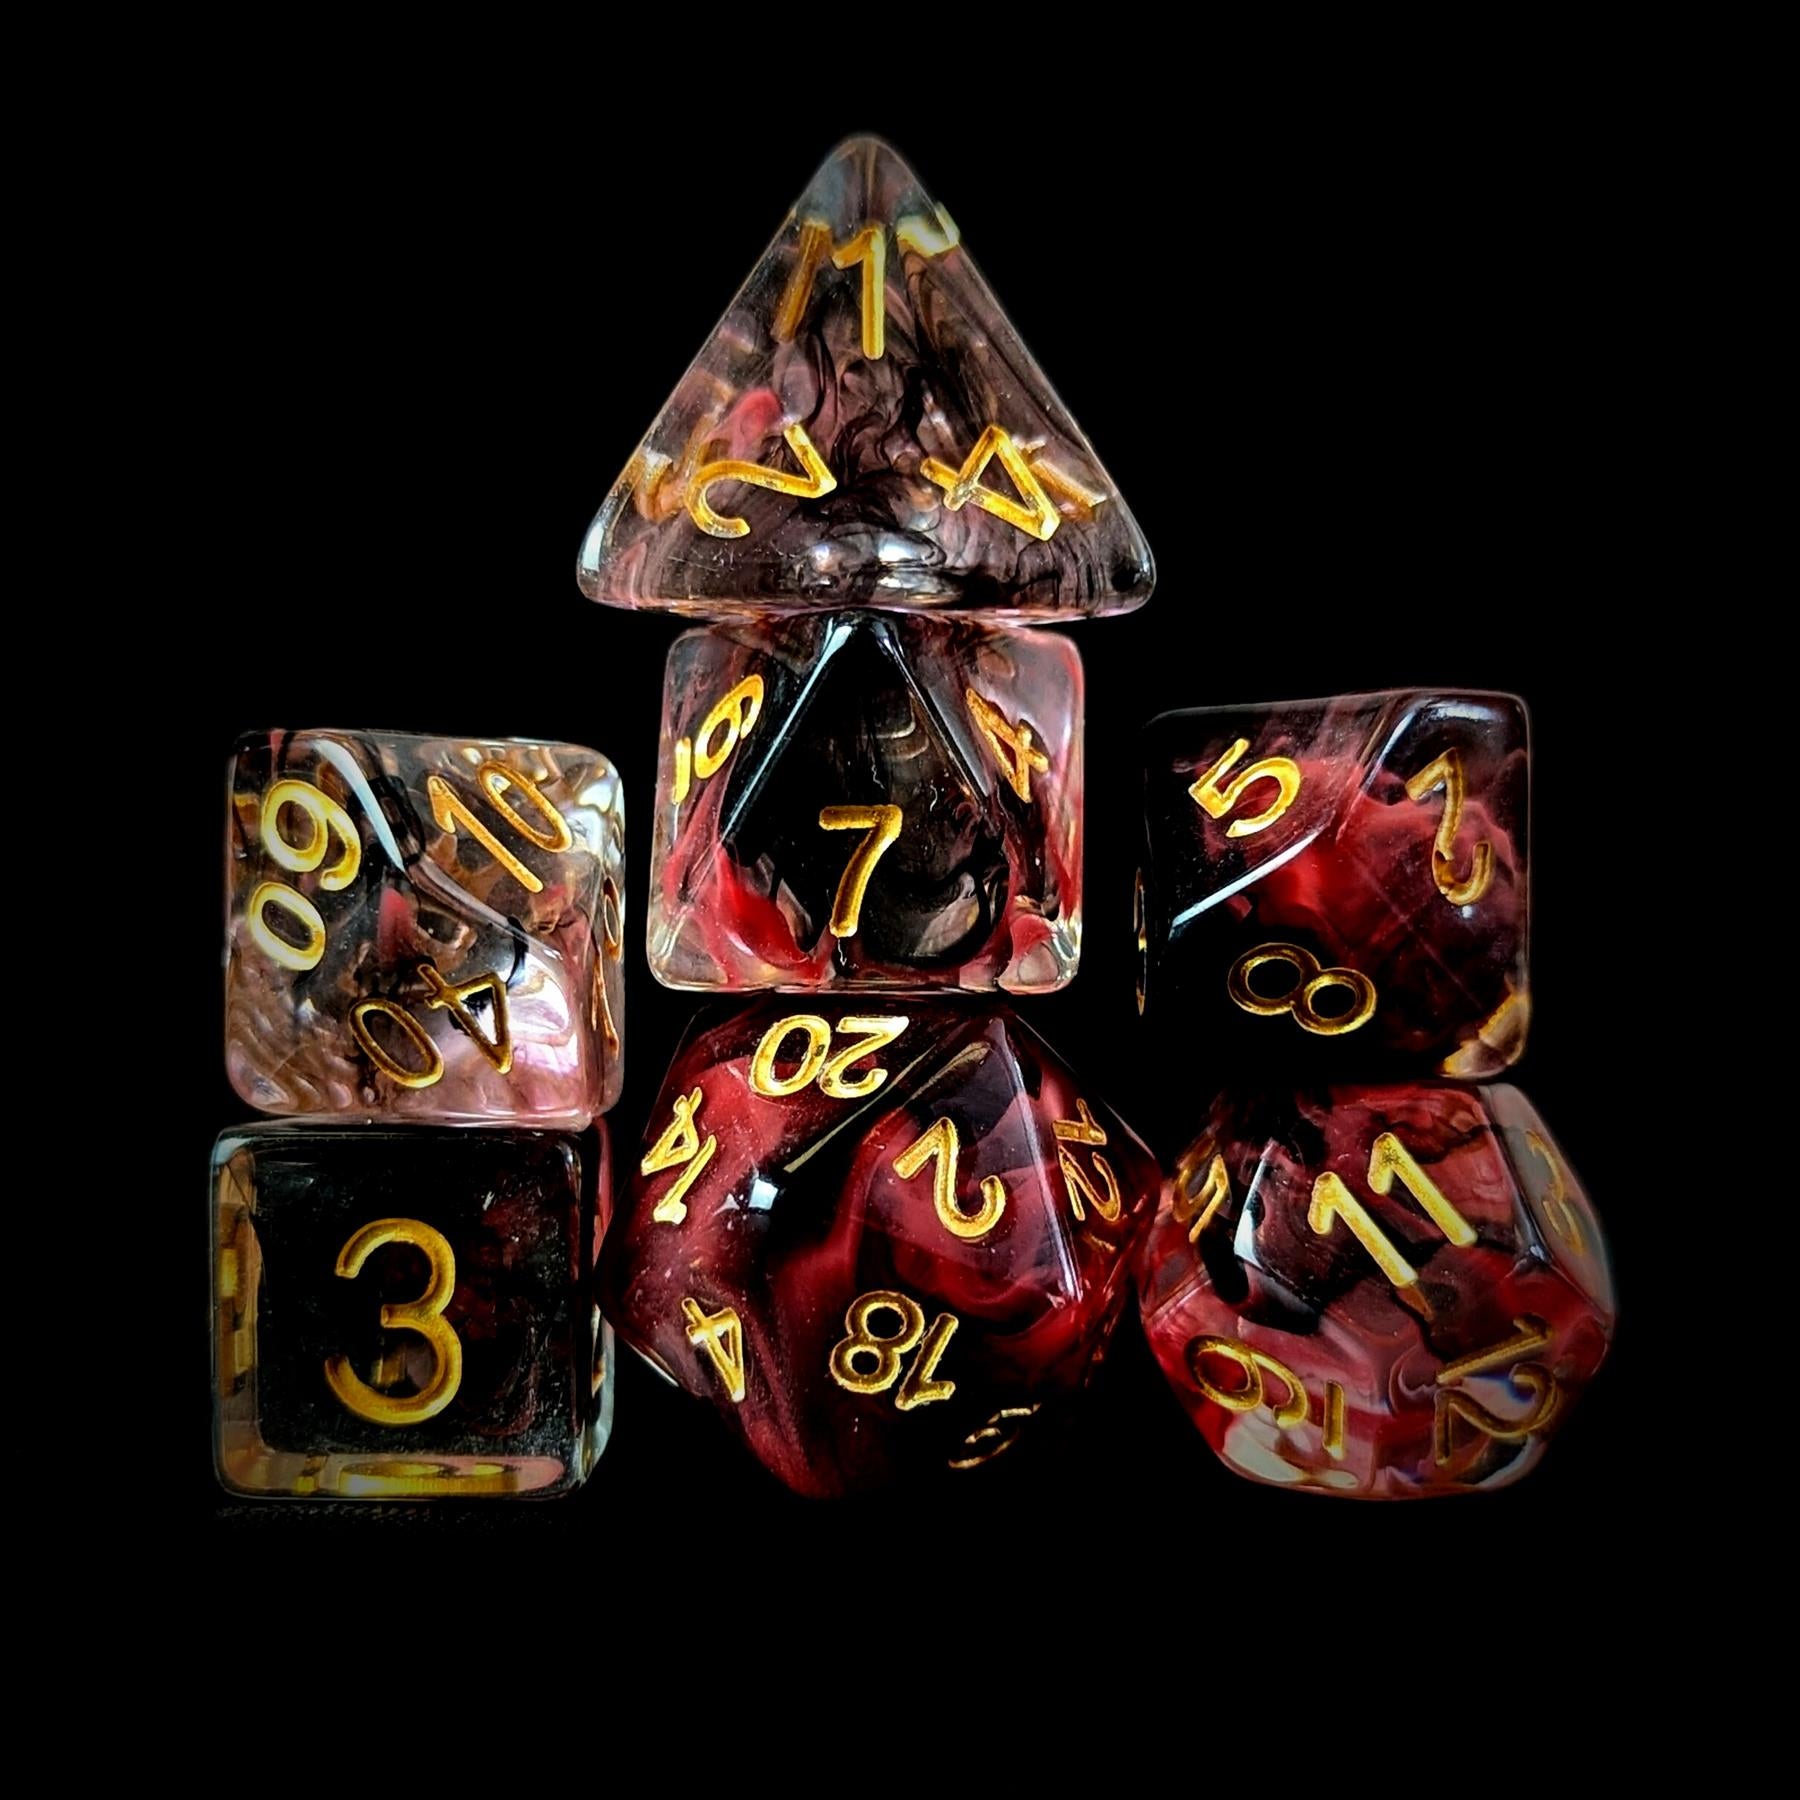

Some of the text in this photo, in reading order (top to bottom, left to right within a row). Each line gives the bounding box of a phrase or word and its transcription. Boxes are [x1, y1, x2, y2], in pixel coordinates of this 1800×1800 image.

[832, 221, 885, 360] 1
[683, 421, 837, 538] 2
[920, 424, 1060, 541] 4
[966, 688, 1049, 803] 4
[1189, 738, 1302, 838] 5
[427, 760, 573, 894] 10
[819, 804, 902, 938] 7
[348, 963, 513, 1089] 40
[1227, 941, 1378, 1037] 8
[749, 1014, 910, 1099] 20
[893, 1116, 1006, 1239] 2
[1307, 1132, 1478, 1287] 11
[324, 1217, 463, 1425] 3
[682, 1296, 746, 1403] 4
[829, 1290, 959, 1411] 18
[1434, 1313, 1561, 1466] 12
